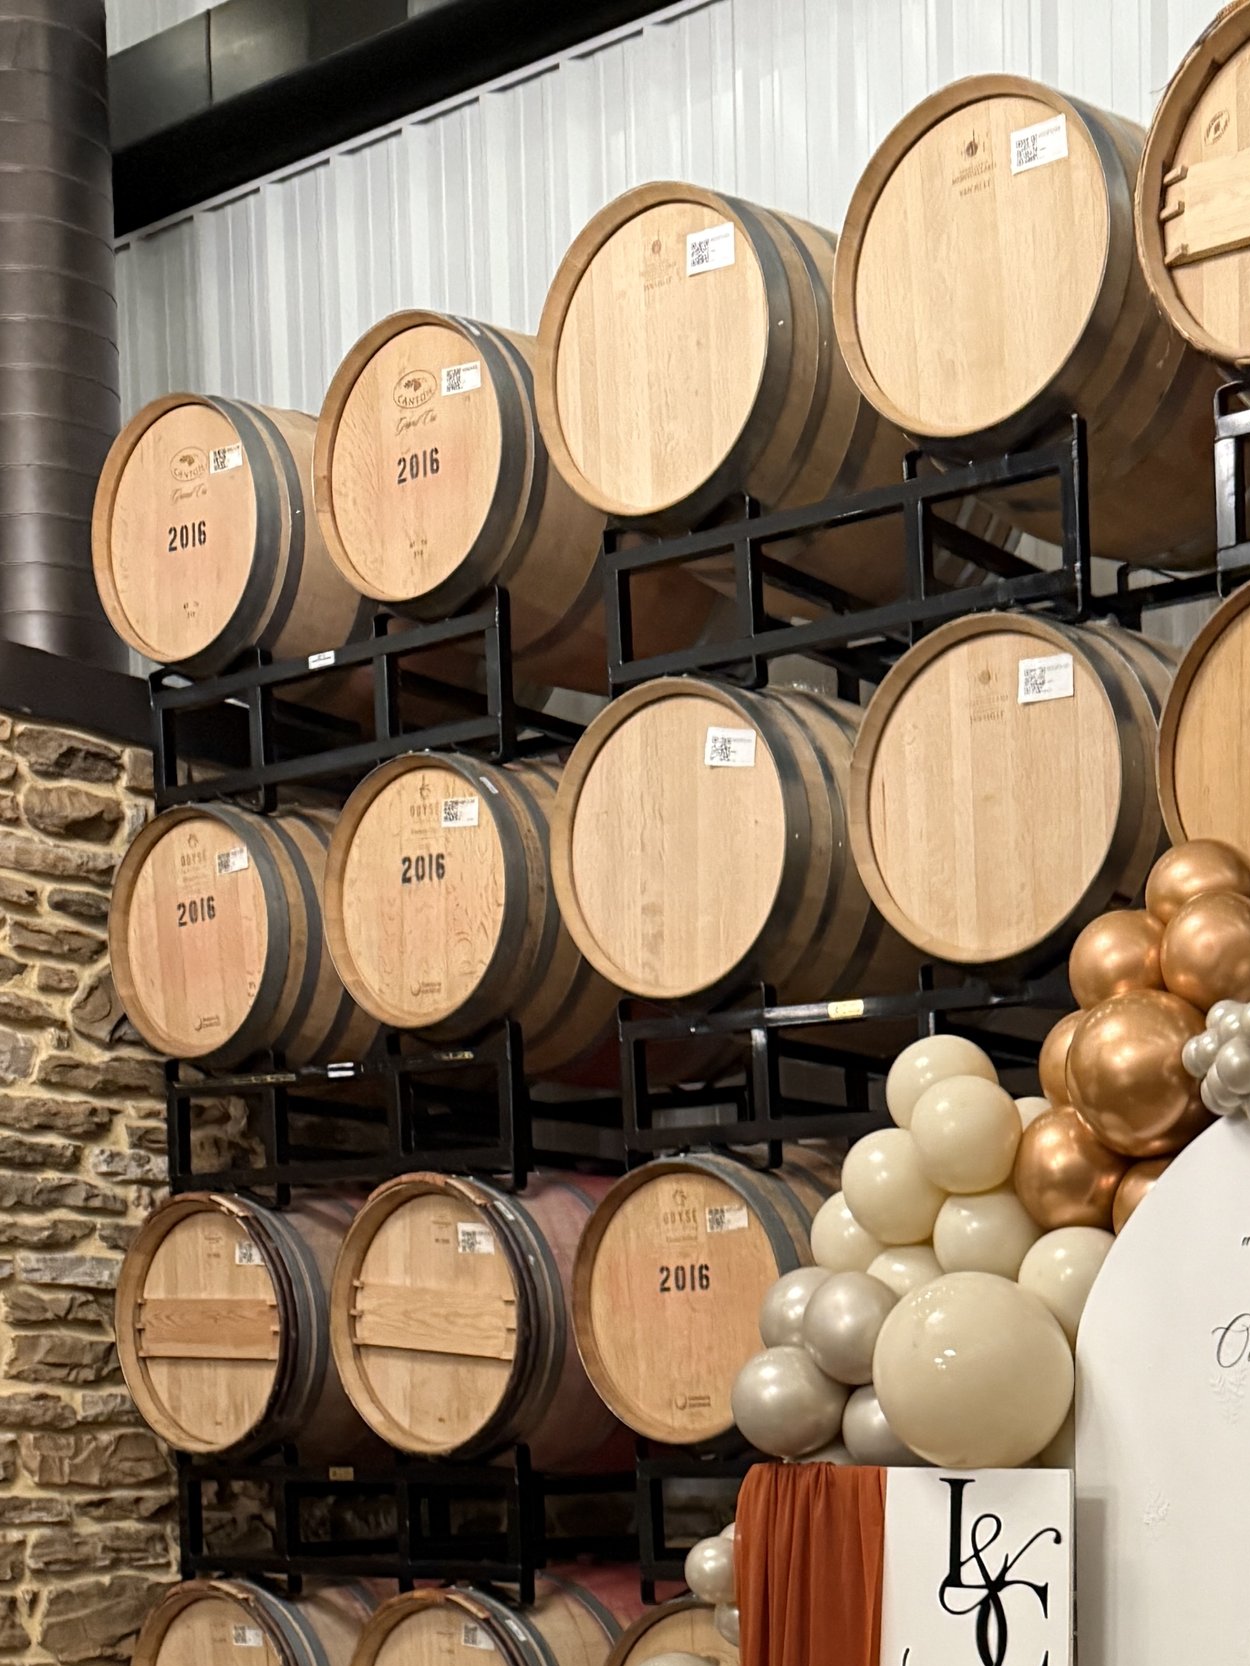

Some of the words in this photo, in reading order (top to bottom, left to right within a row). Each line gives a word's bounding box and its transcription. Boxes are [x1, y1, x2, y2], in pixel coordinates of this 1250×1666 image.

[397, 447, 441, 486] 2016
[168, 521, 206, 553] 2016
[402, 853, 446, 884] 2016
[177, 896, 216, 927] 2016
[659, 1263, 710, 1293] 2016
